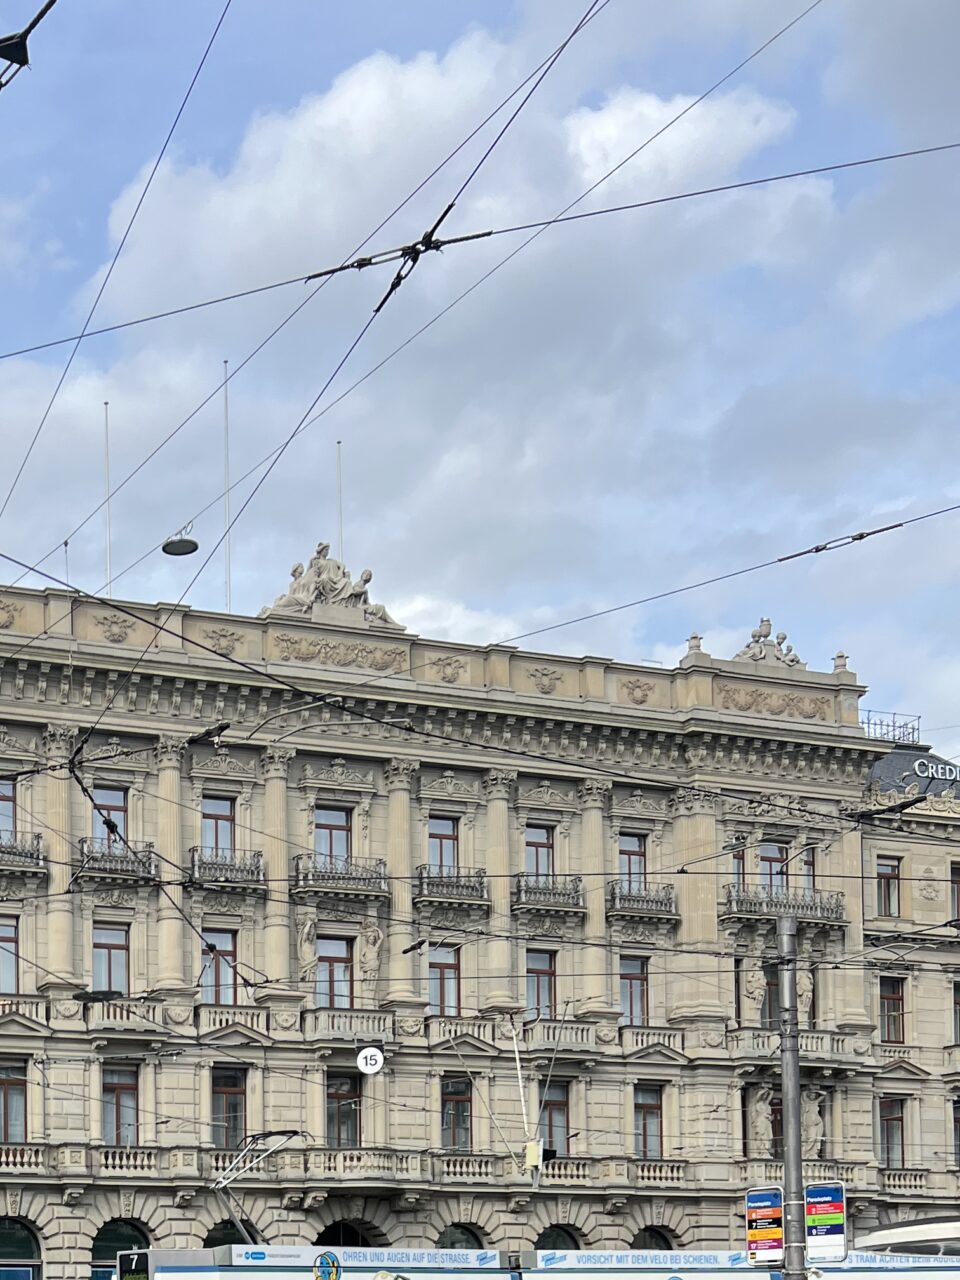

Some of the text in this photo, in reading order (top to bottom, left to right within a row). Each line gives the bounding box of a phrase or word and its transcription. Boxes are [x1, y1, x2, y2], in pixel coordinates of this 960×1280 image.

[914, 759, 960, 780] CREDI
[362, 1055, 378, 1067] 15
[130, 1254, 138, 1270] 7
[342, 1251, 368, 1263] OHREN
[369, 1251, 385, 1263] UND
[387, 1252, 411, 1264] AUGEN
[412, 1252, 425, 1264] AUF
[427, 1253, 439, 1264] DIE
[576, 1254, 614, 1264] VORSICHT
[616, 1254, 629, 1264] MIT
[631, 1254, 648, 1264] DEM
[649, 1254, 668, 1264] VELO
[670, 1254, 682, 1264] BEI
[683, 1254, 720, 1264] SCHIENEN.
[855, 1254, 877, 1264] TRAM
